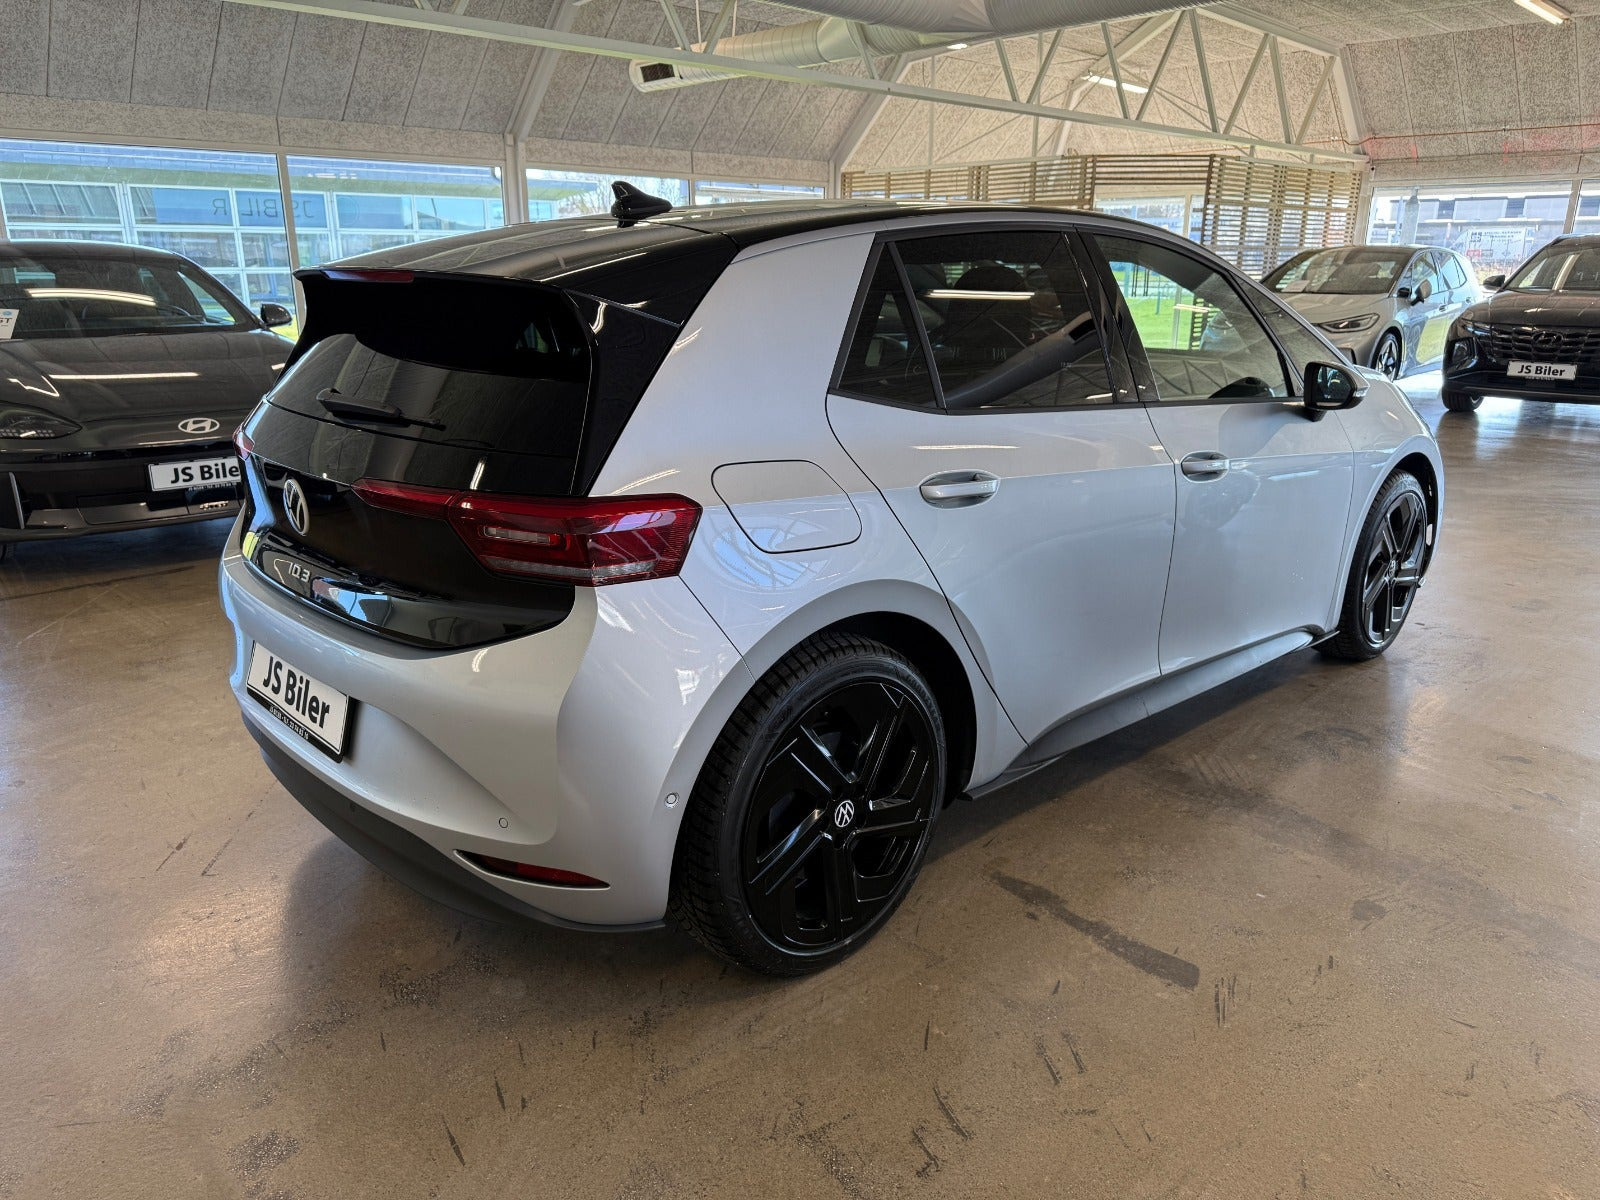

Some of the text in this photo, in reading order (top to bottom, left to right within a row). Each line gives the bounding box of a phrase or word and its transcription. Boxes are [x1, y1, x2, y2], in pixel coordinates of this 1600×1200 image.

[1517, 364, 1566, 376] JS Biler
[170, 466, 194, 484] JS
[262, 655, 283, 695] JS
[284, 669, 331, 729] Biler
